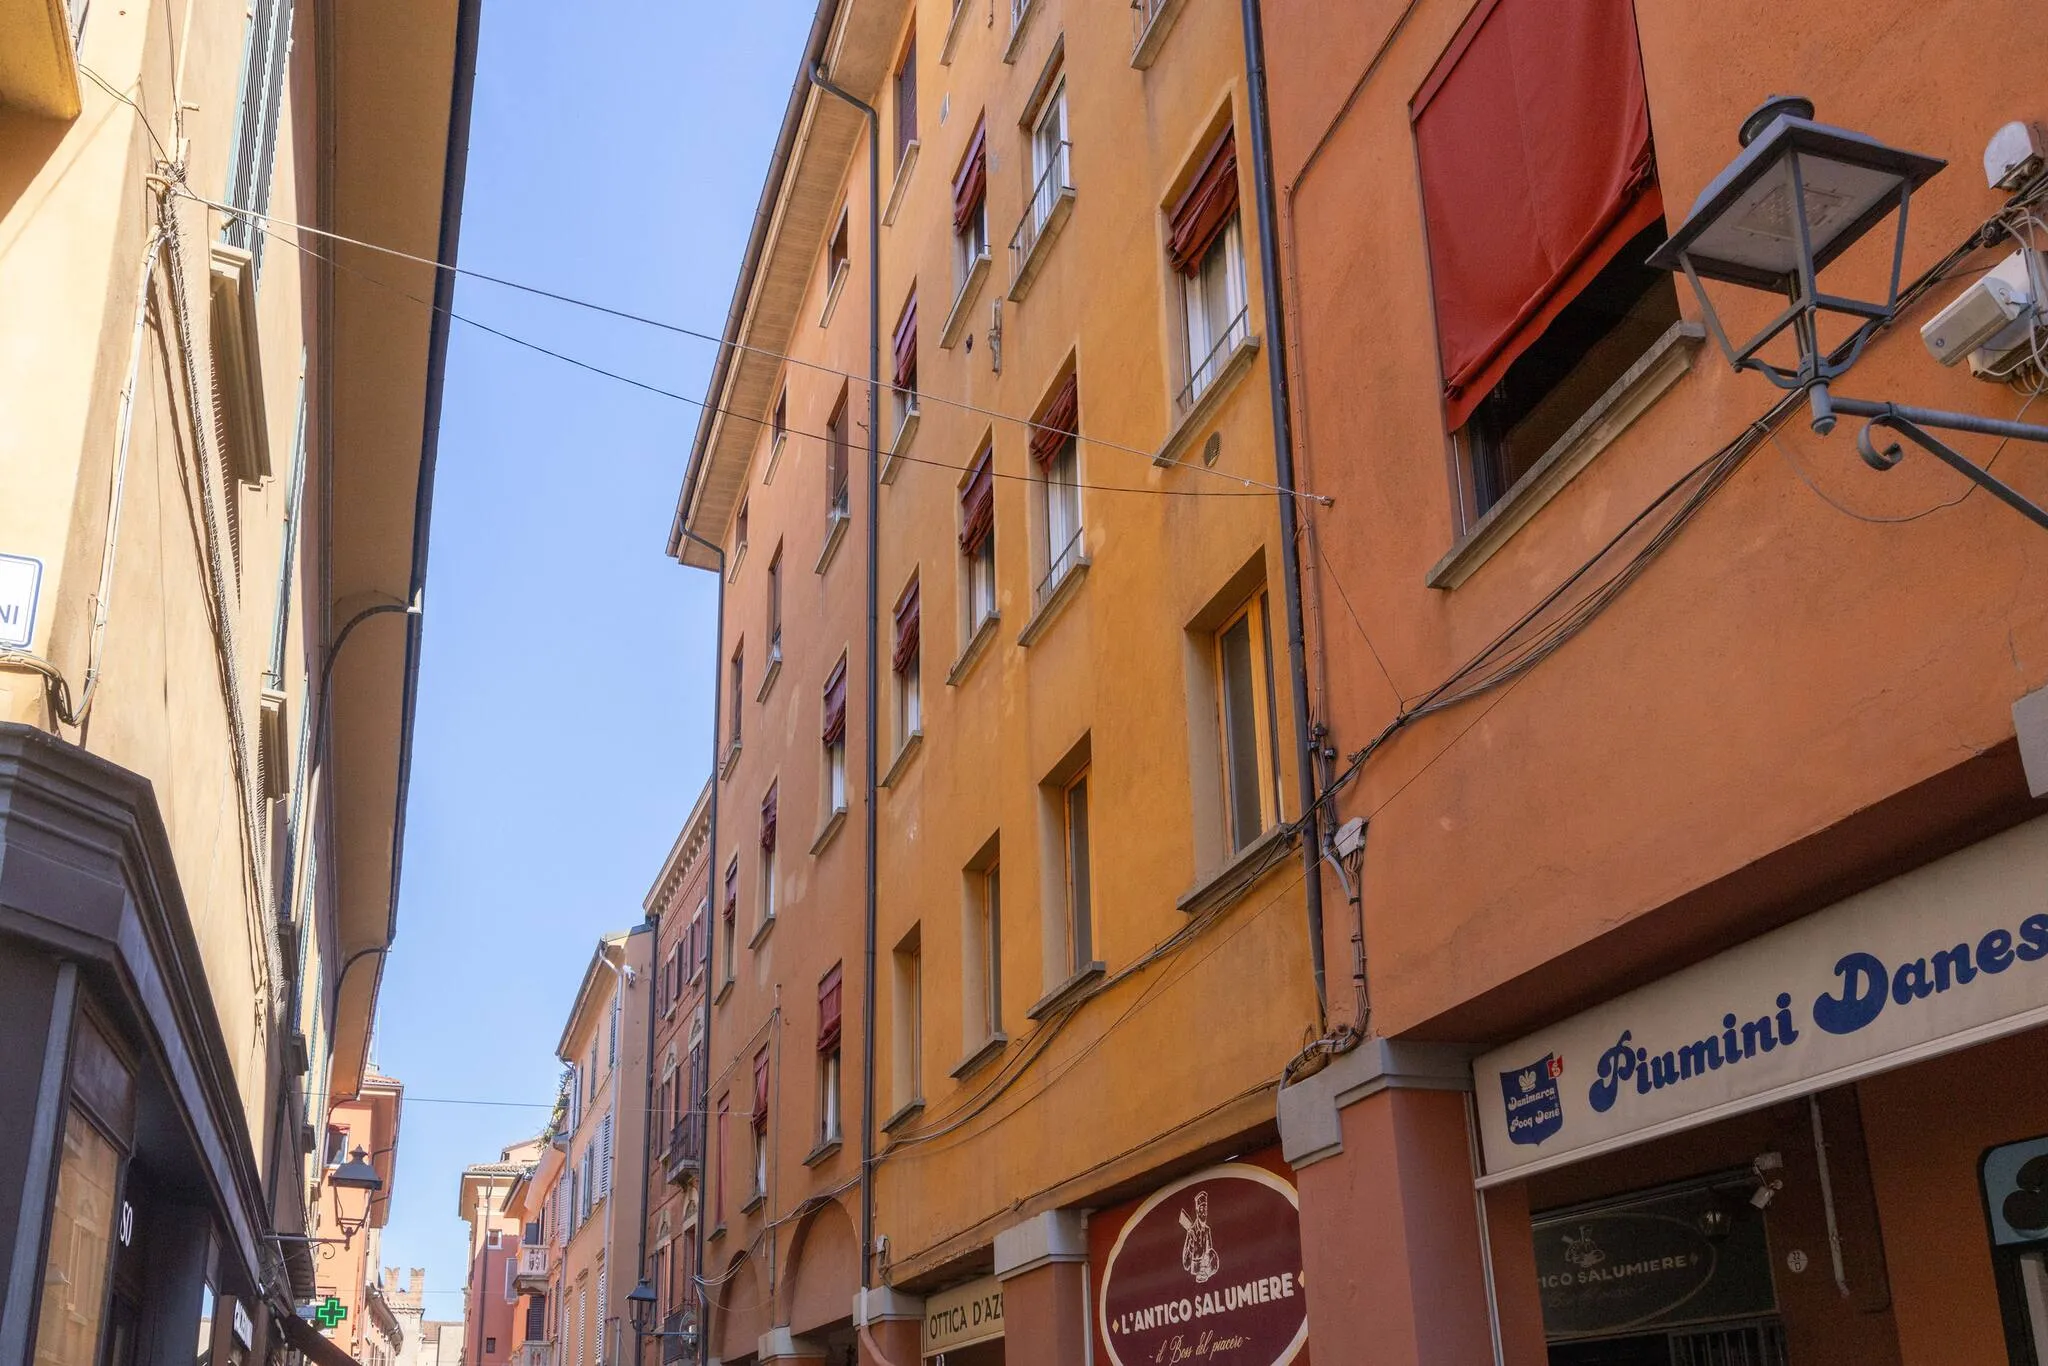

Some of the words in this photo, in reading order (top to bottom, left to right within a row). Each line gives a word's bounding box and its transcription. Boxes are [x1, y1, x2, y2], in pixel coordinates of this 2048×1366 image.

[1589, 992, 1799, 1113] Piumini
[1508, 1087, 1556, 1111] Danimarca
[1578, 1255, 1687, 1284] SALUMIERE
[1121, 1298, 1192, 1335] L'ANTICO
[1195, 1276, 1295, 1318] SALUMIERE
[930, 1306, 967, 1340] OTTICA
[1196, 1329, 1214, 1356] del
[1209, 1335, 1244, 1361] piacere
